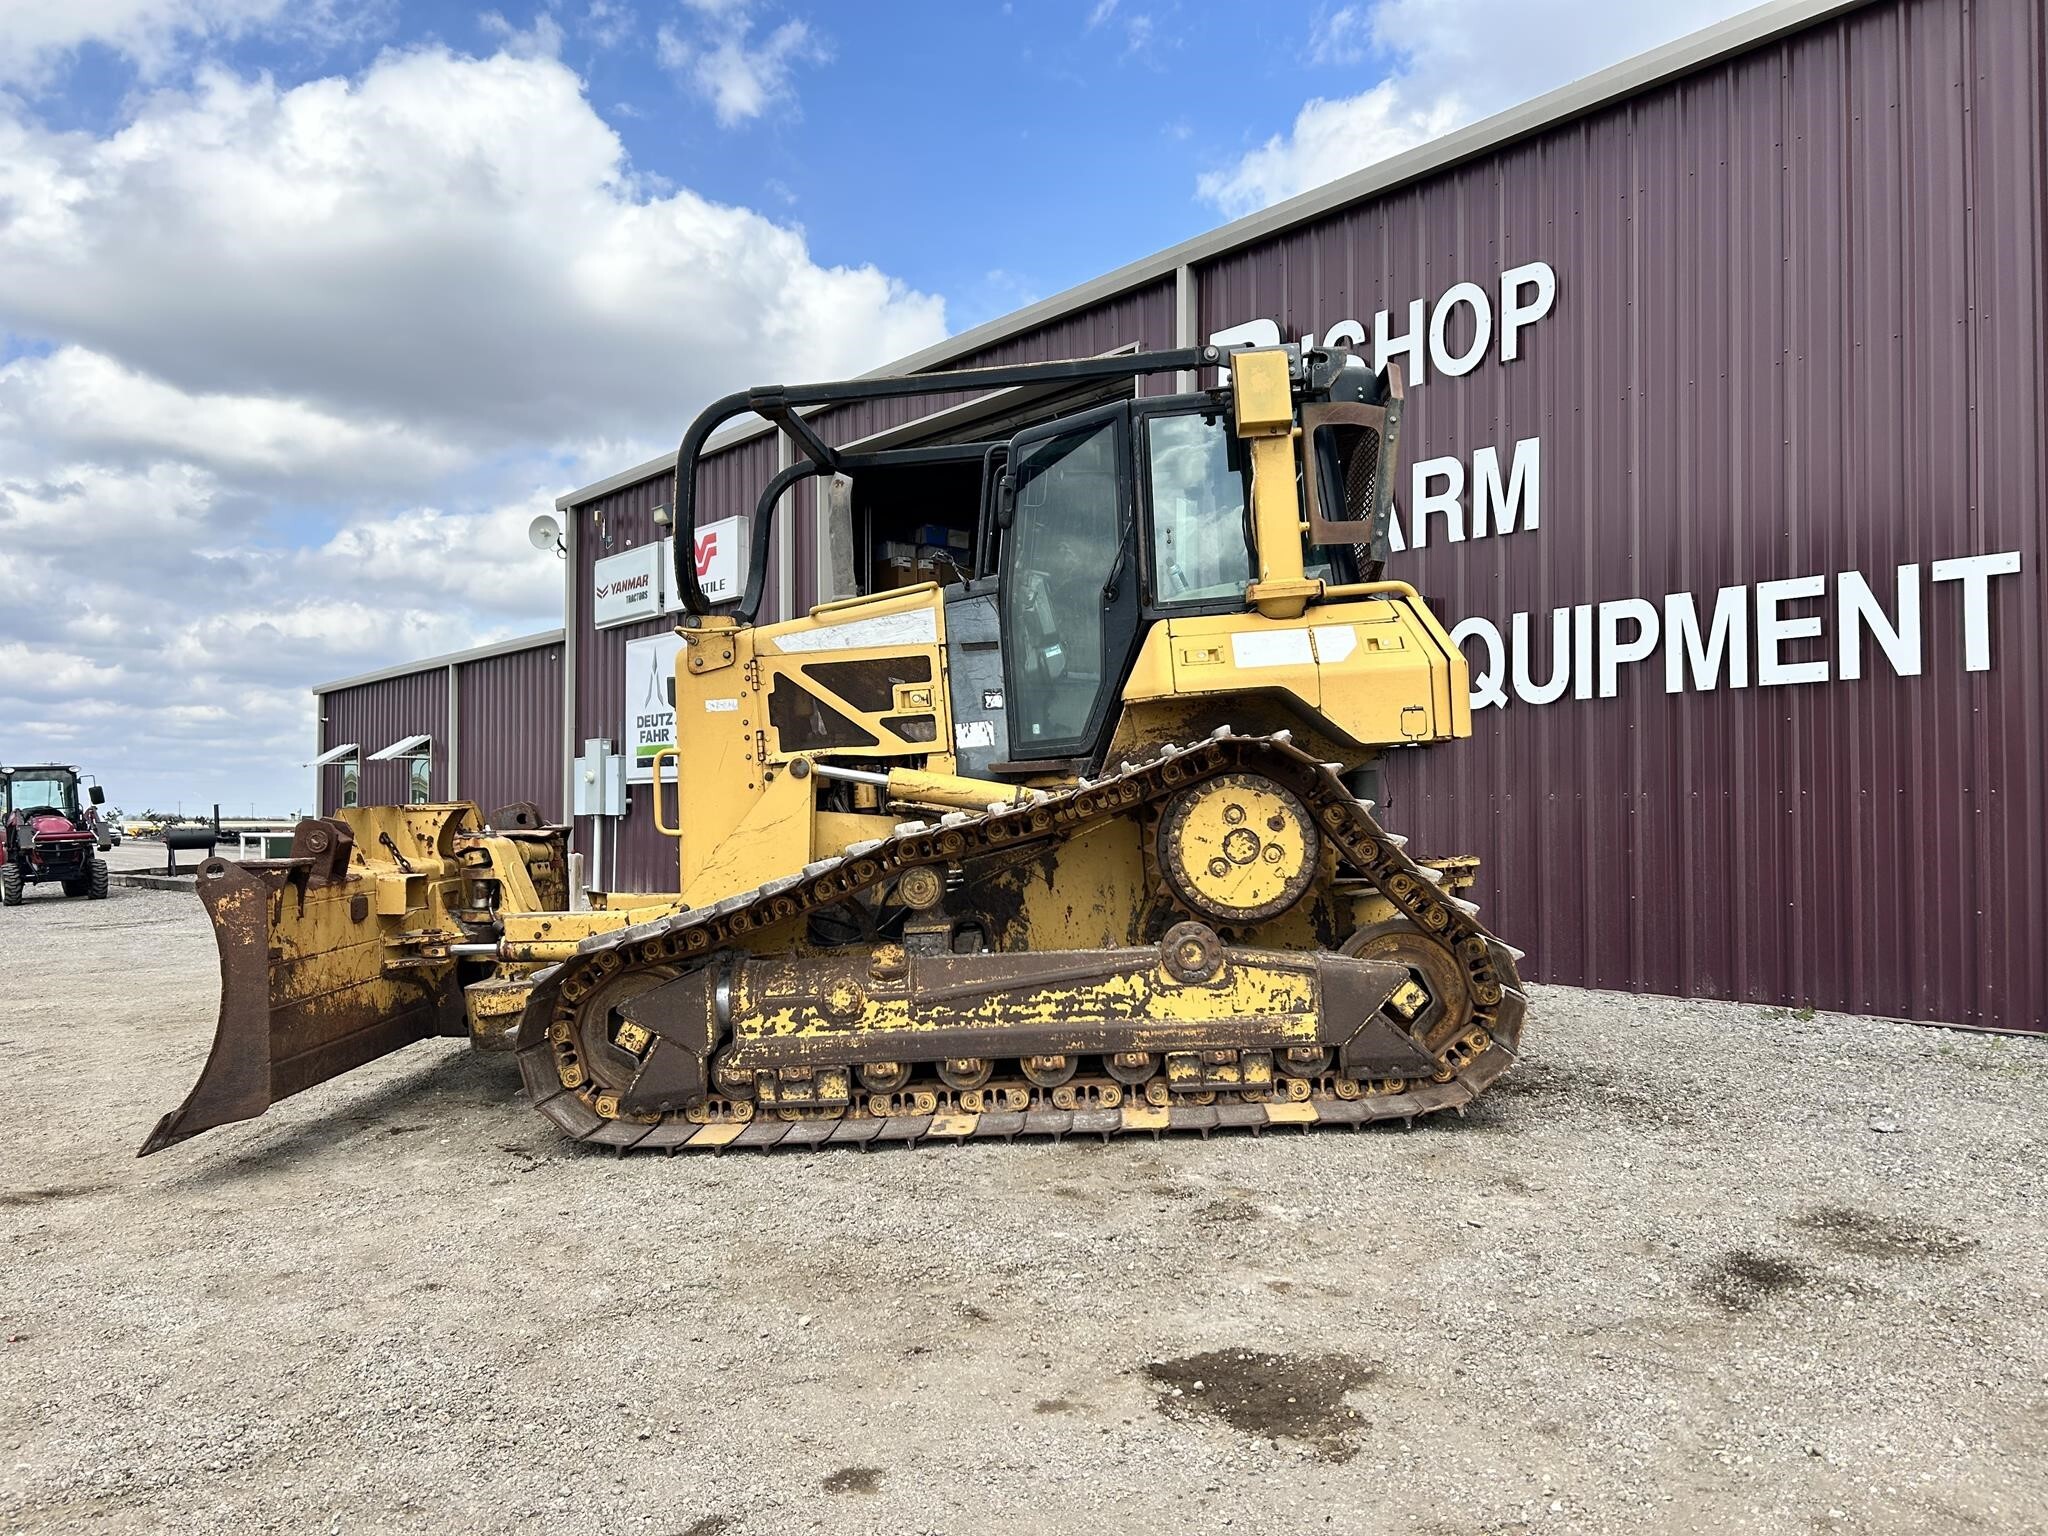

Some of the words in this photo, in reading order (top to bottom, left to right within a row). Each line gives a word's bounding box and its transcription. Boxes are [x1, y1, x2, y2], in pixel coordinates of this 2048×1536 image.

[610, 574, 649, 596] YANMAR
[1449, 551, 2021, 710] QUIPMENT
[636, 712, 673, 728] DEUTZ
[639, 728, 670, 743] FAHR
